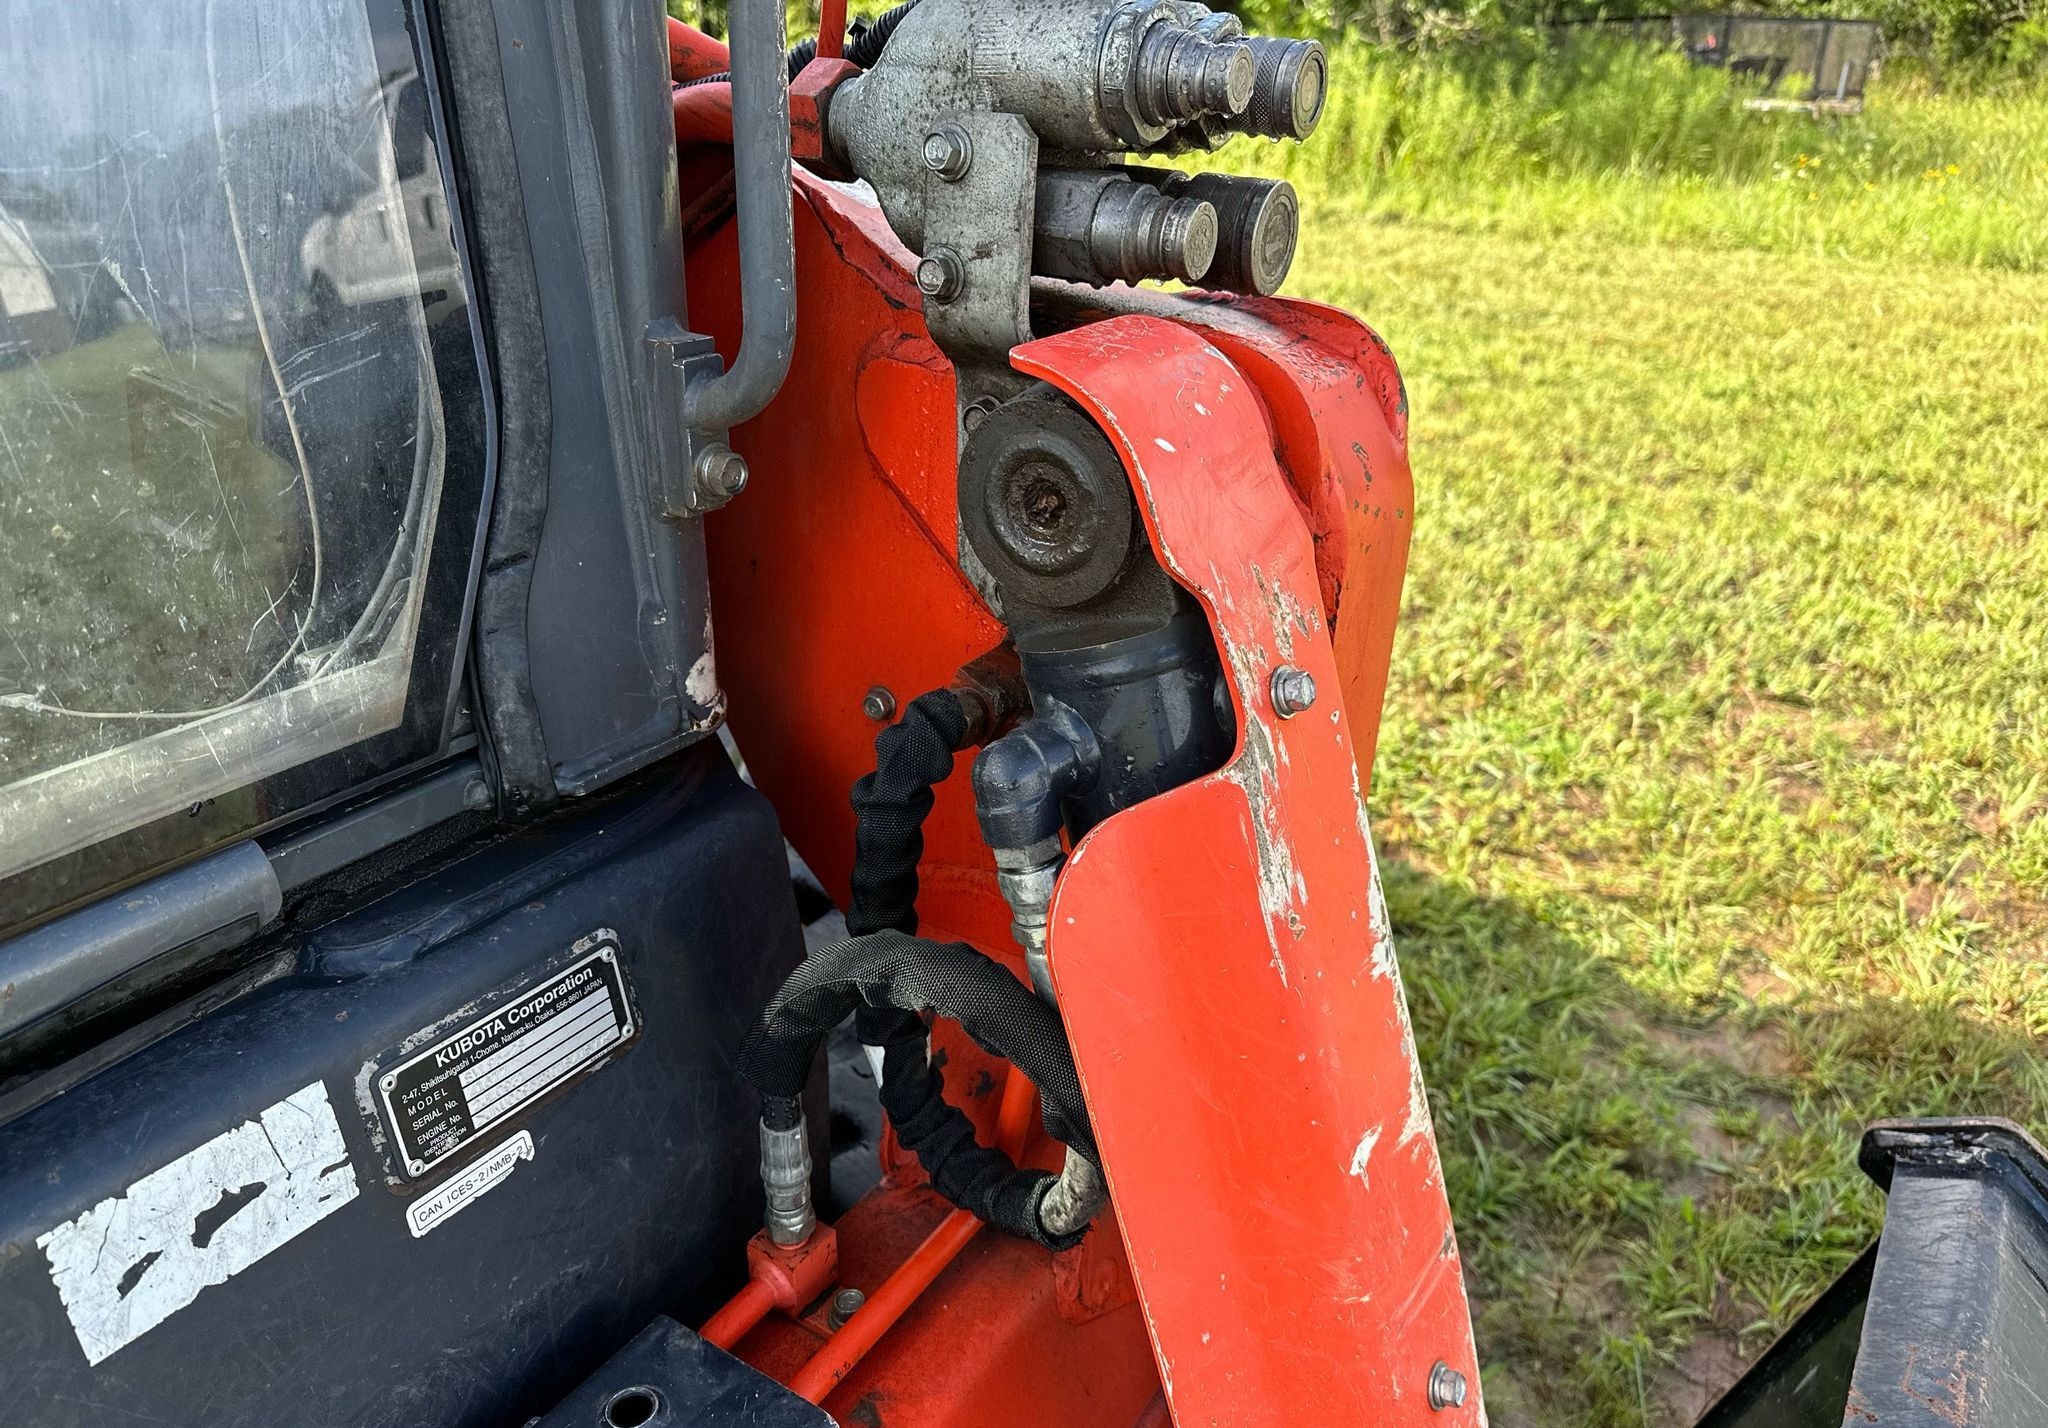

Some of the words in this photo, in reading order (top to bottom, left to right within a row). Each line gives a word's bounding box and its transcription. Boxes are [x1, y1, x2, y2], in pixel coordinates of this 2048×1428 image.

[435, 1018, 506, 1068] KUBOTA
[507, 967, 594, 1024] Corporation
[420, 1058, 470, 1093] Shikitsuhigashi
[469, 1041, 502, 1064] 1-Chome,
[501, 1021, 536, 1045] Naniwa-ku,
[556, 990, 583, 1011] 556-8601
[583, 977, 603, 995] JAPAN
[407, 1088, 448, 1117] MODEL
[412, 1108, 443, 1131] SERIAL
[444, 1100, 458, 1111] No.
[417, 1120, 448, 1145] ENGINE
[449, 1114, 462, 1125] No.
[430, 1125, 457, 1146] PRODUCT
[419, 1200, 443, 1223] CAN
[446, 1145, 524, 1204] ICES-2/NMB-2
